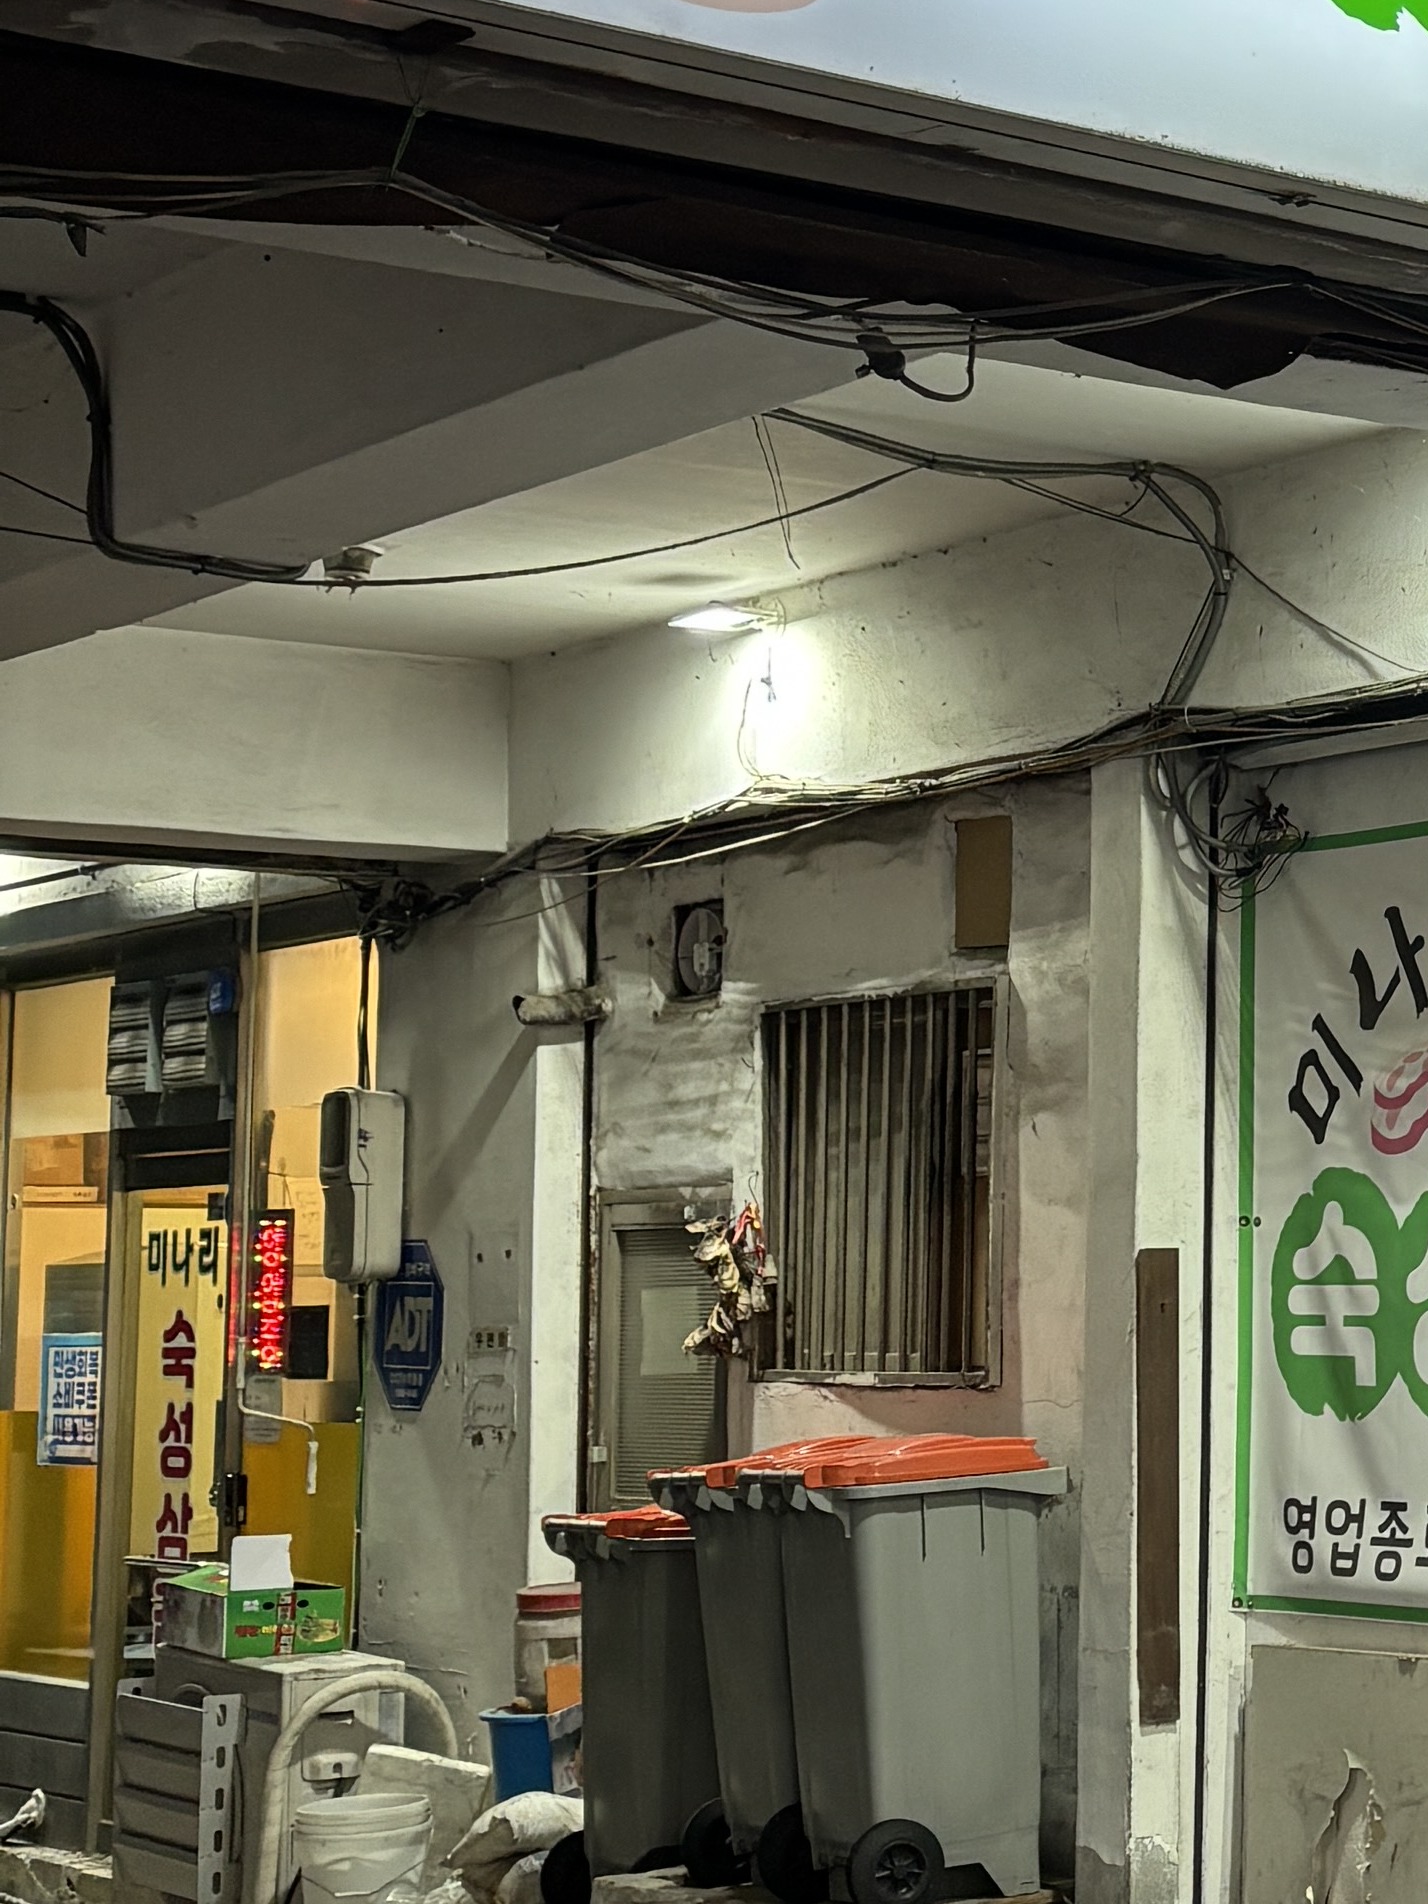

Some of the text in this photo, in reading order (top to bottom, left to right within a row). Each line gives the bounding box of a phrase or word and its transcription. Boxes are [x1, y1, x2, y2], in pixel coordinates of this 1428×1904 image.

[147, 1226, 221, 1288] 미나리
[384, 1296, 434, 1353] ADT
[153, 1309, 197, 1646] 숙성삼
